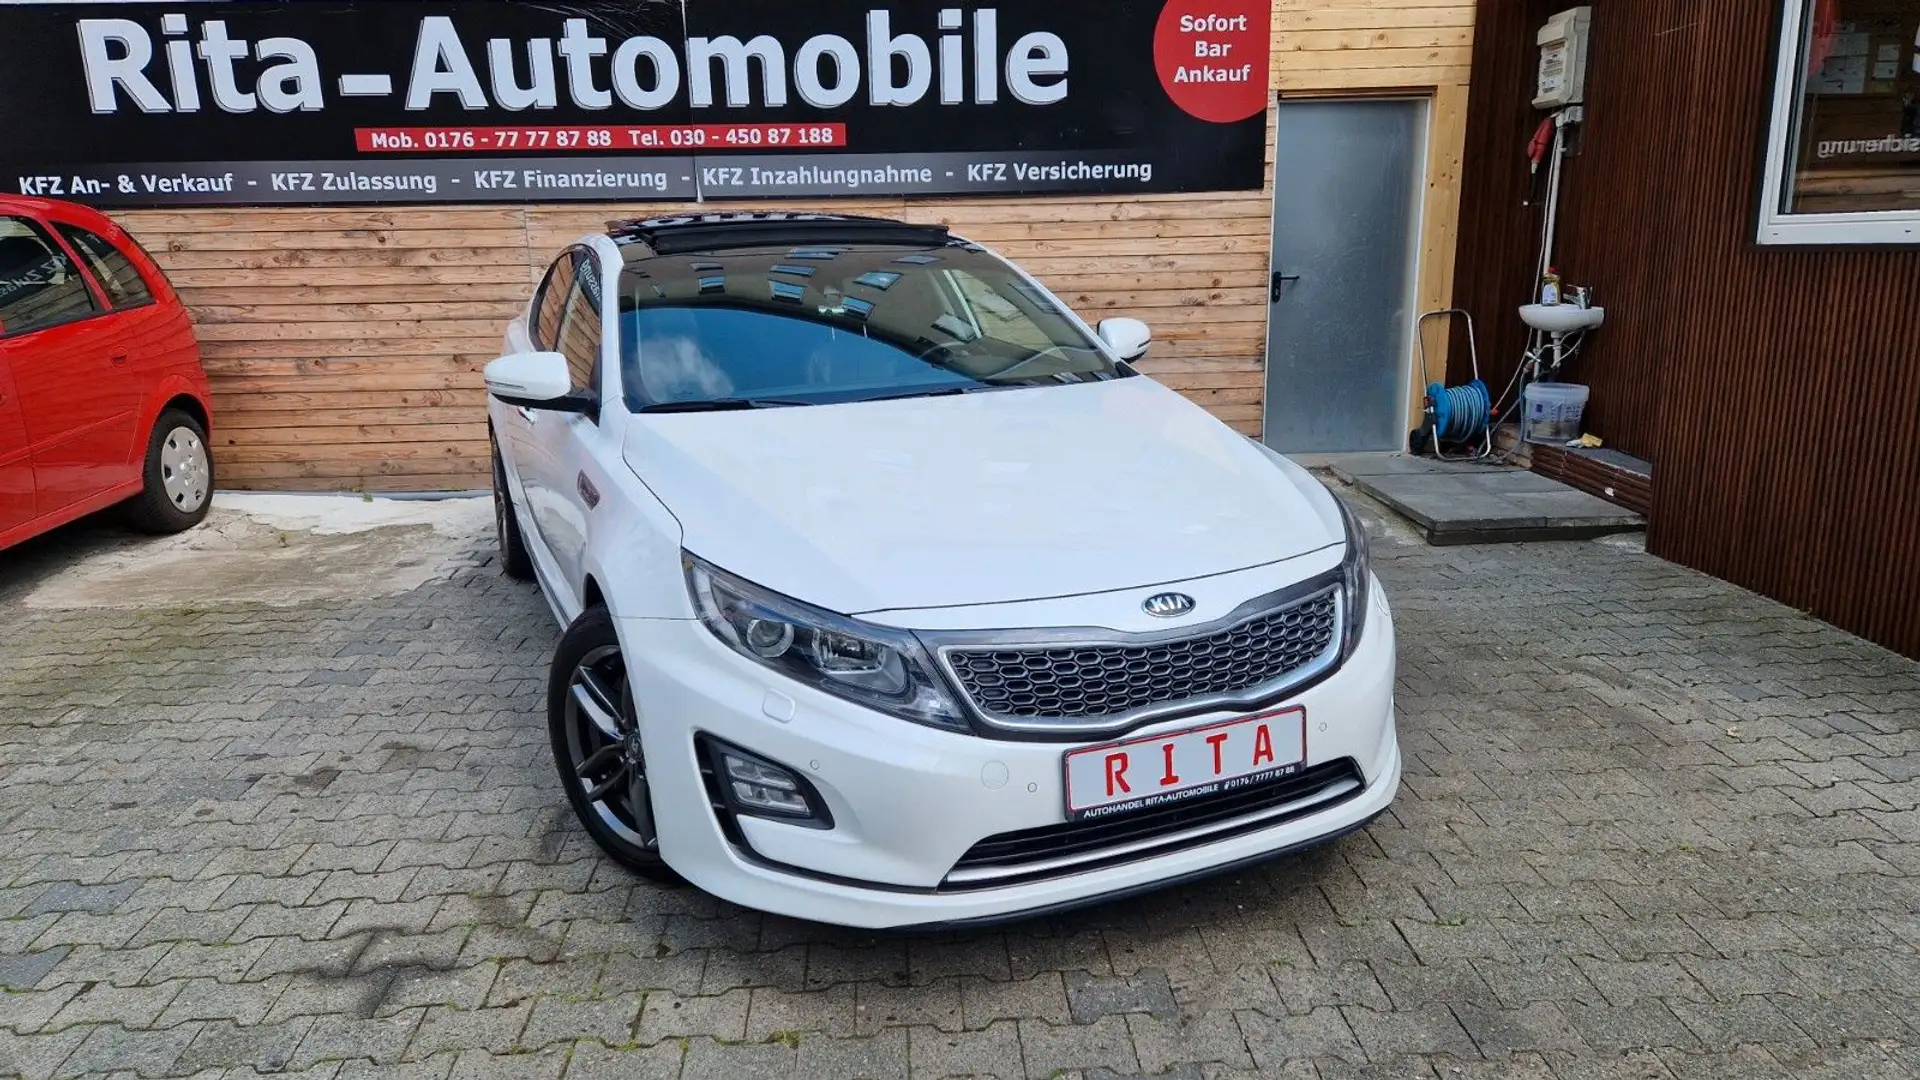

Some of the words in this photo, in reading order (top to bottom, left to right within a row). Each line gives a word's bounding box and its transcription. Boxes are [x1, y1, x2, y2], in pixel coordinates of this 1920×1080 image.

[1180, 14, 1248, 32] Sofort
[1195, 40, 1232, 57] Bar
[1173, 64, 1252, 83] Ankauf
[371, 132, 419, 148] Mob.
[424, 131, 474, 148] 0176
[494, 131, 519, 147] 77
[525, 131, 550, 147] 77
[556, 130, 580, 147] 87
[587, 130, 612, 146] 88
[628, 129, 664, 146] Tel.
[670, 129, 705, 146] 030
[726, 128, 762, 144] 450
[767, 128, 791, 144] 87
[798, 127, 833, 144] 188
[19, 176, 64, 195] KFZ
[71, 175, 110, 194] An-
[117, 174, 137, 193] &
[141, 173, 233, 193] Verkauf
[271, 172, 316, 191] KFZ
[321, 171, 437, 193] Zulassung
[474, 170, 517, 189] KFZ
[523, 169, 667, 191] Finanzierung
[703, 167, 744, 186] KFZ
[750, 165, 932, 188] Inzahlungnahme
[968, 163, 1007, 181] KFZ
[1013, 161, 1153, 182] Versicherung
[1149, 595, 1190, 612] KIA
[1083, 799, 1145, 818] AUTOHANDEL
